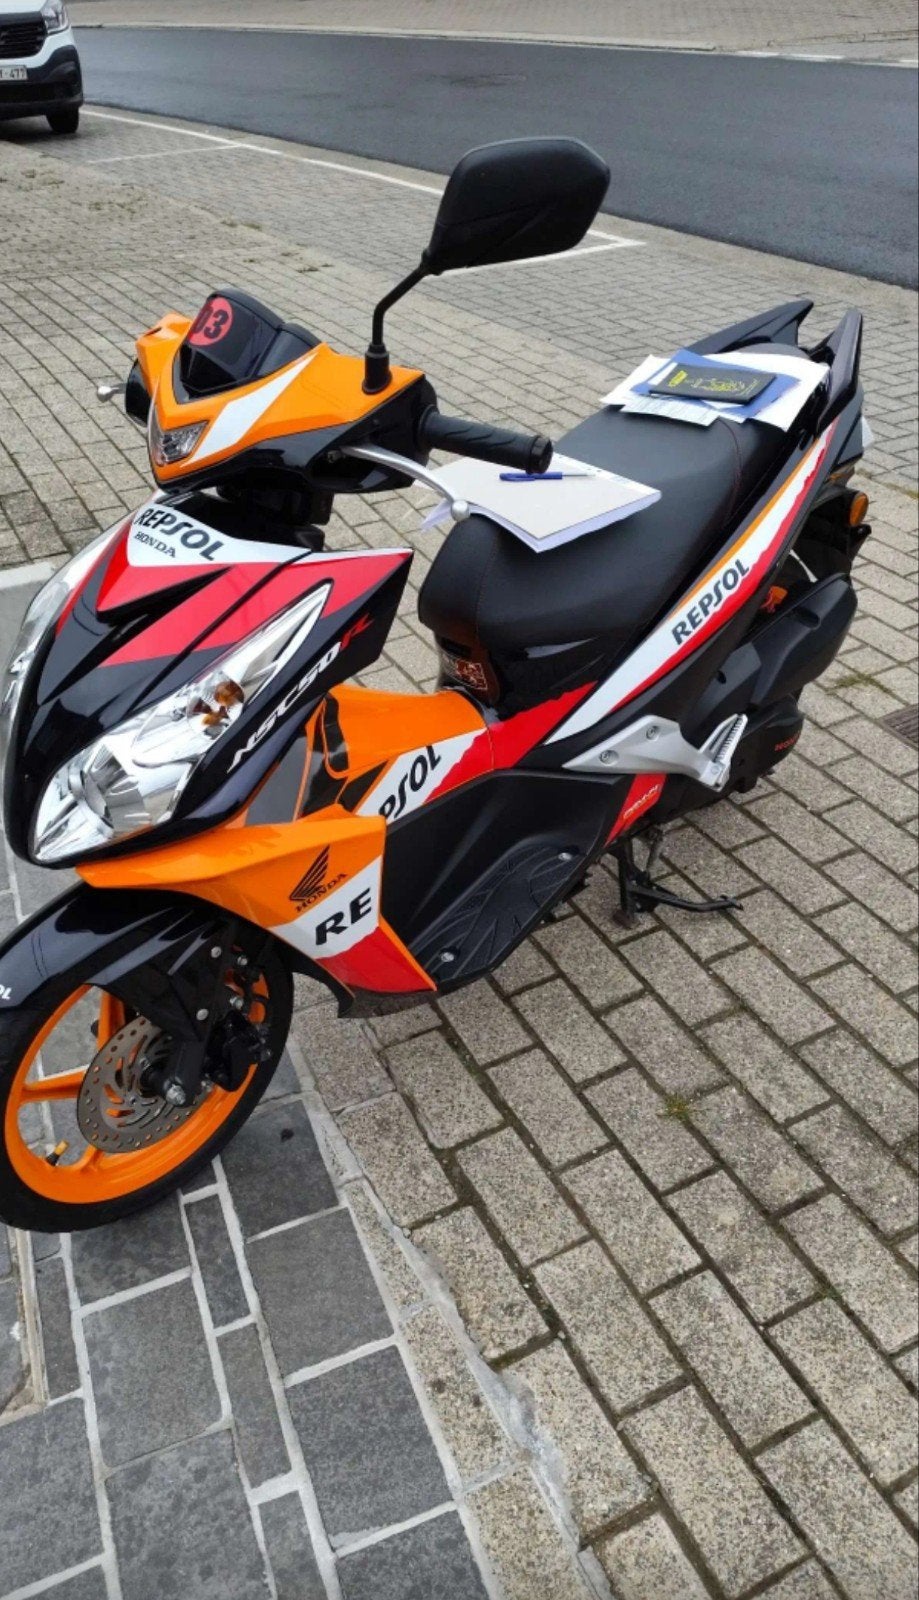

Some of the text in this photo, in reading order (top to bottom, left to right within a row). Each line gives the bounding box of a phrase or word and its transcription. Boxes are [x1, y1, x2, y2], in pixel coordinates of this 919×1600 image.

[134, 508, 224, 561] REPSOL
[134, 531, 176, 558] HONDA
[672, 559, 749, 645] REPSOL
[296, 873, 347, 912] HONDA
[316, 887, 372, 946] RE
